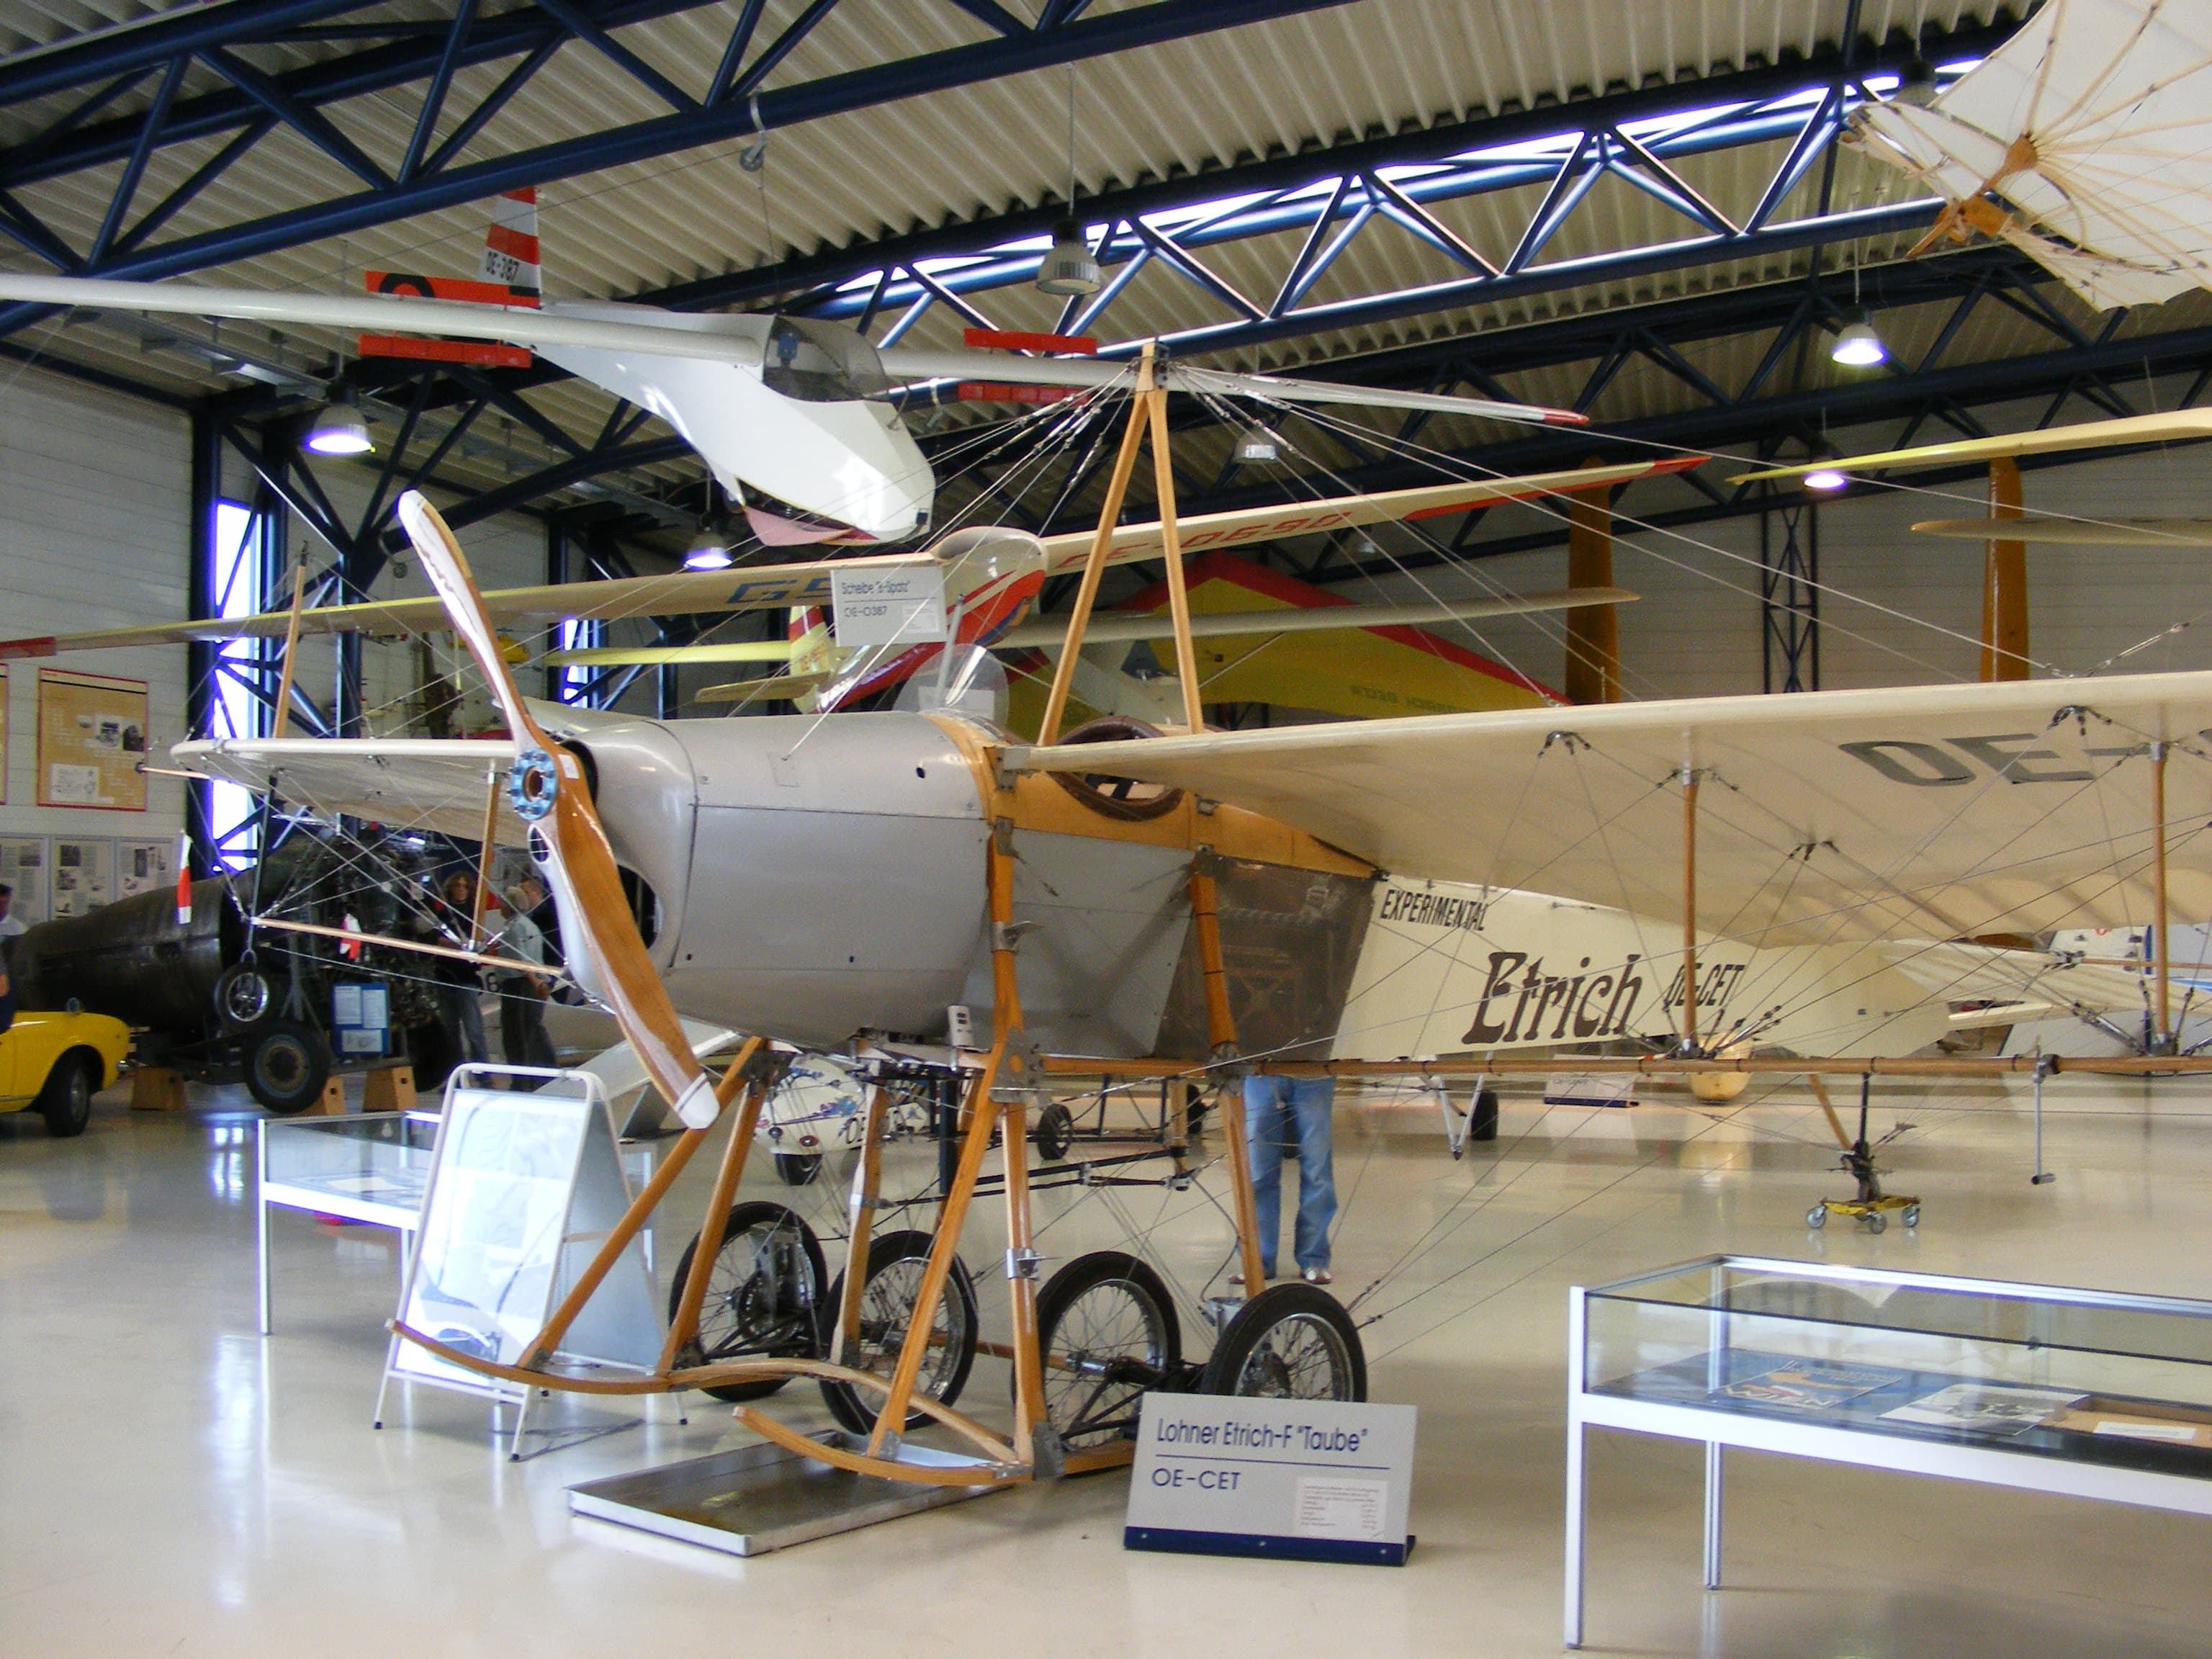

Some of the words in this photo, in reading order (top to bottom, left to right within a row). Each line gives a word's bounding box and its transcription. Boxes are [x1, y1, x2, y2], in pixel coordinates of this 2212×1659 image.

[1838, 726, 2212, 787] OE-
[1380, 889, 1489, 931] EXPERIMENTAL
[1461, 951, 1642, 1045] Etrich
[1157, 1418, 1220, 1445] Lohner
[1223, 1421, 1293, 1448] Etrich-F
[1296, 1425, 1368, 1452] "Taube"
[1152, 1467, 1242, 1490] OE-CET
